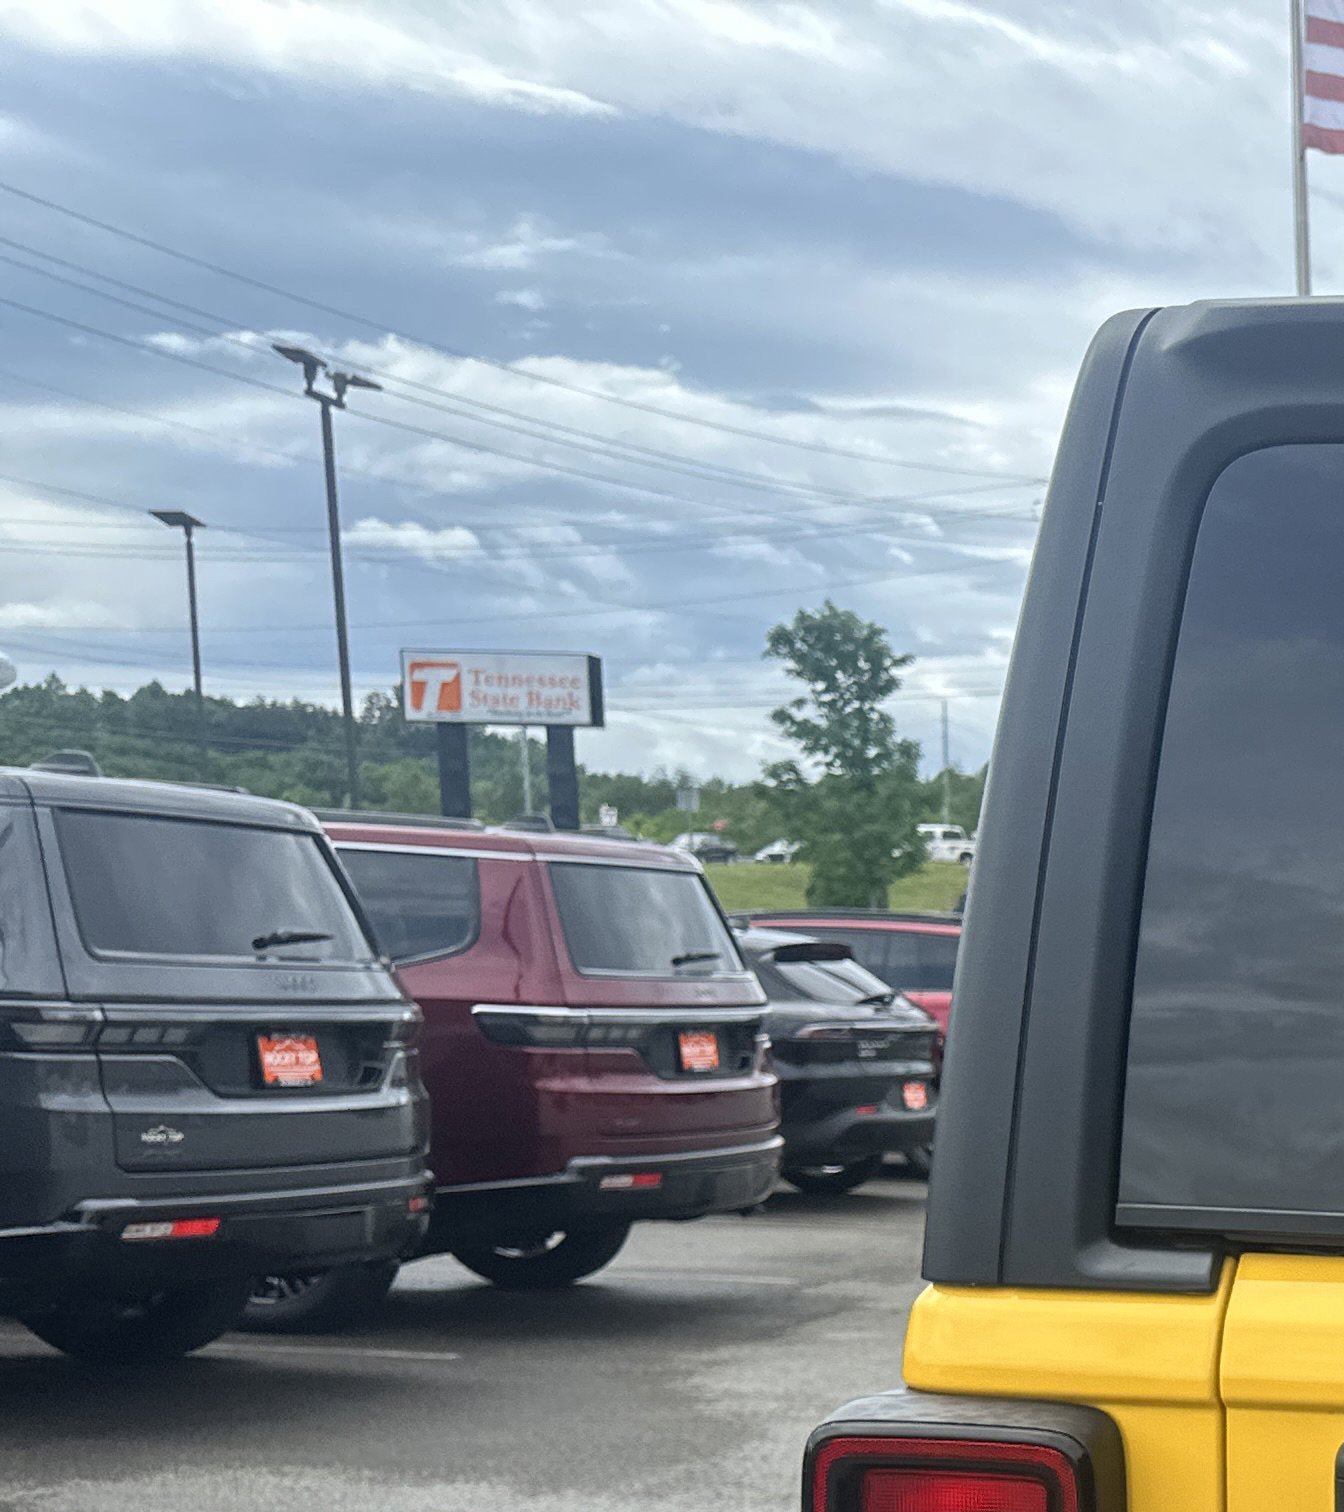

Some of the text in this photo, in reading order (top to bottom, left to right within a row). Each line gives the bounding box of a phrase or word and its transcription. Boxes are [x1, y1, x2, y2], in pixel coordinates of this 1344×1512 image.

[469, 669, 581, 689] Tennessee
[469, 689, 581, 710] State Bank
